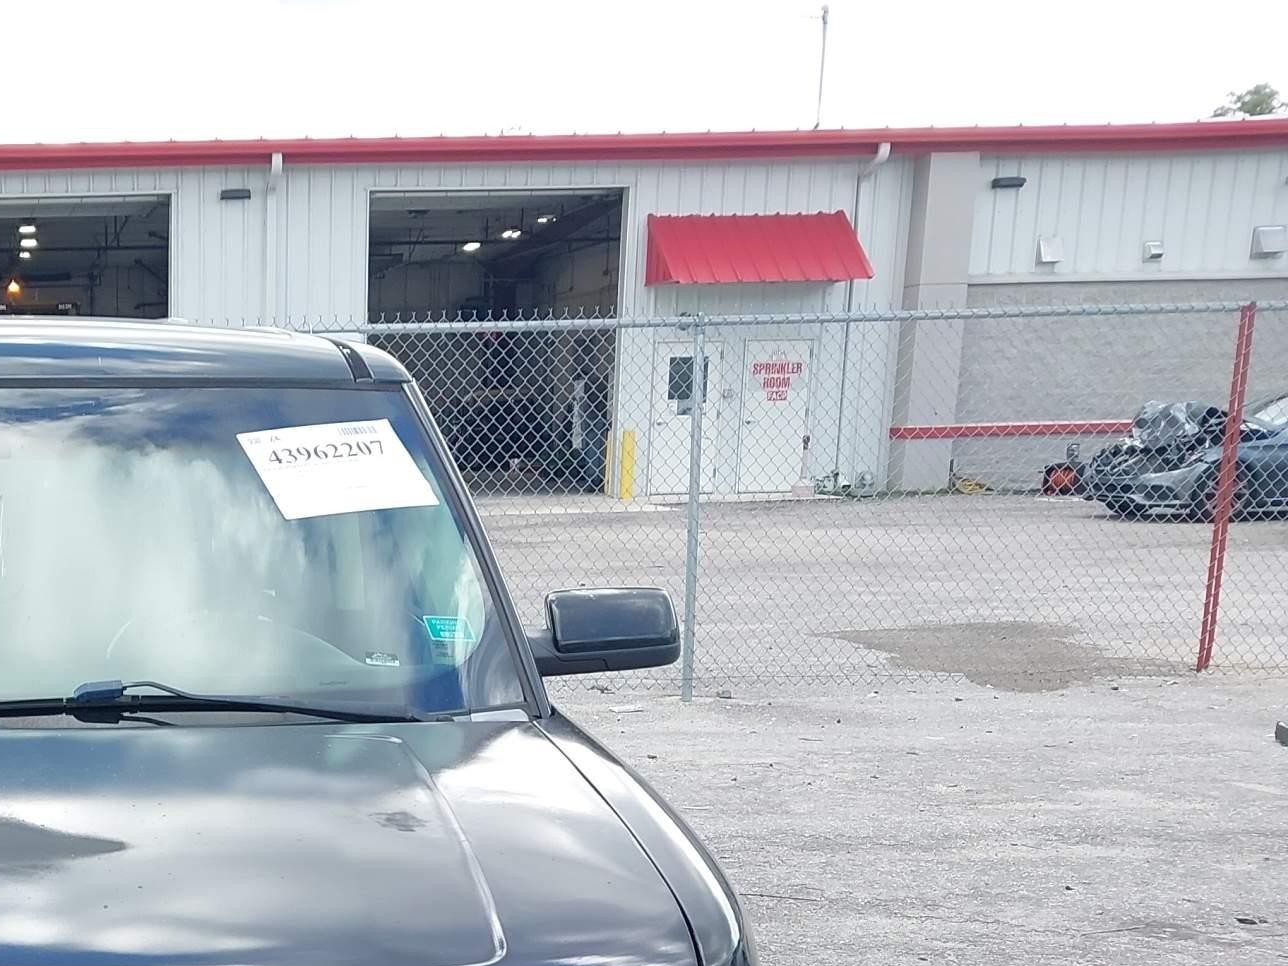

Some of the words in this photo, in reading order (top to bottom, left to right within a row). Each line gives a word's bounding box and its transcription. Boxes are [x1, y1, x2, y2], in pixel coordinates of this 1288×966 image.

[752, 362, 802, 375] SPRINKLER
[762, 377, 790, 389] ROOM
[268, 440, 384, 465] 43962207
